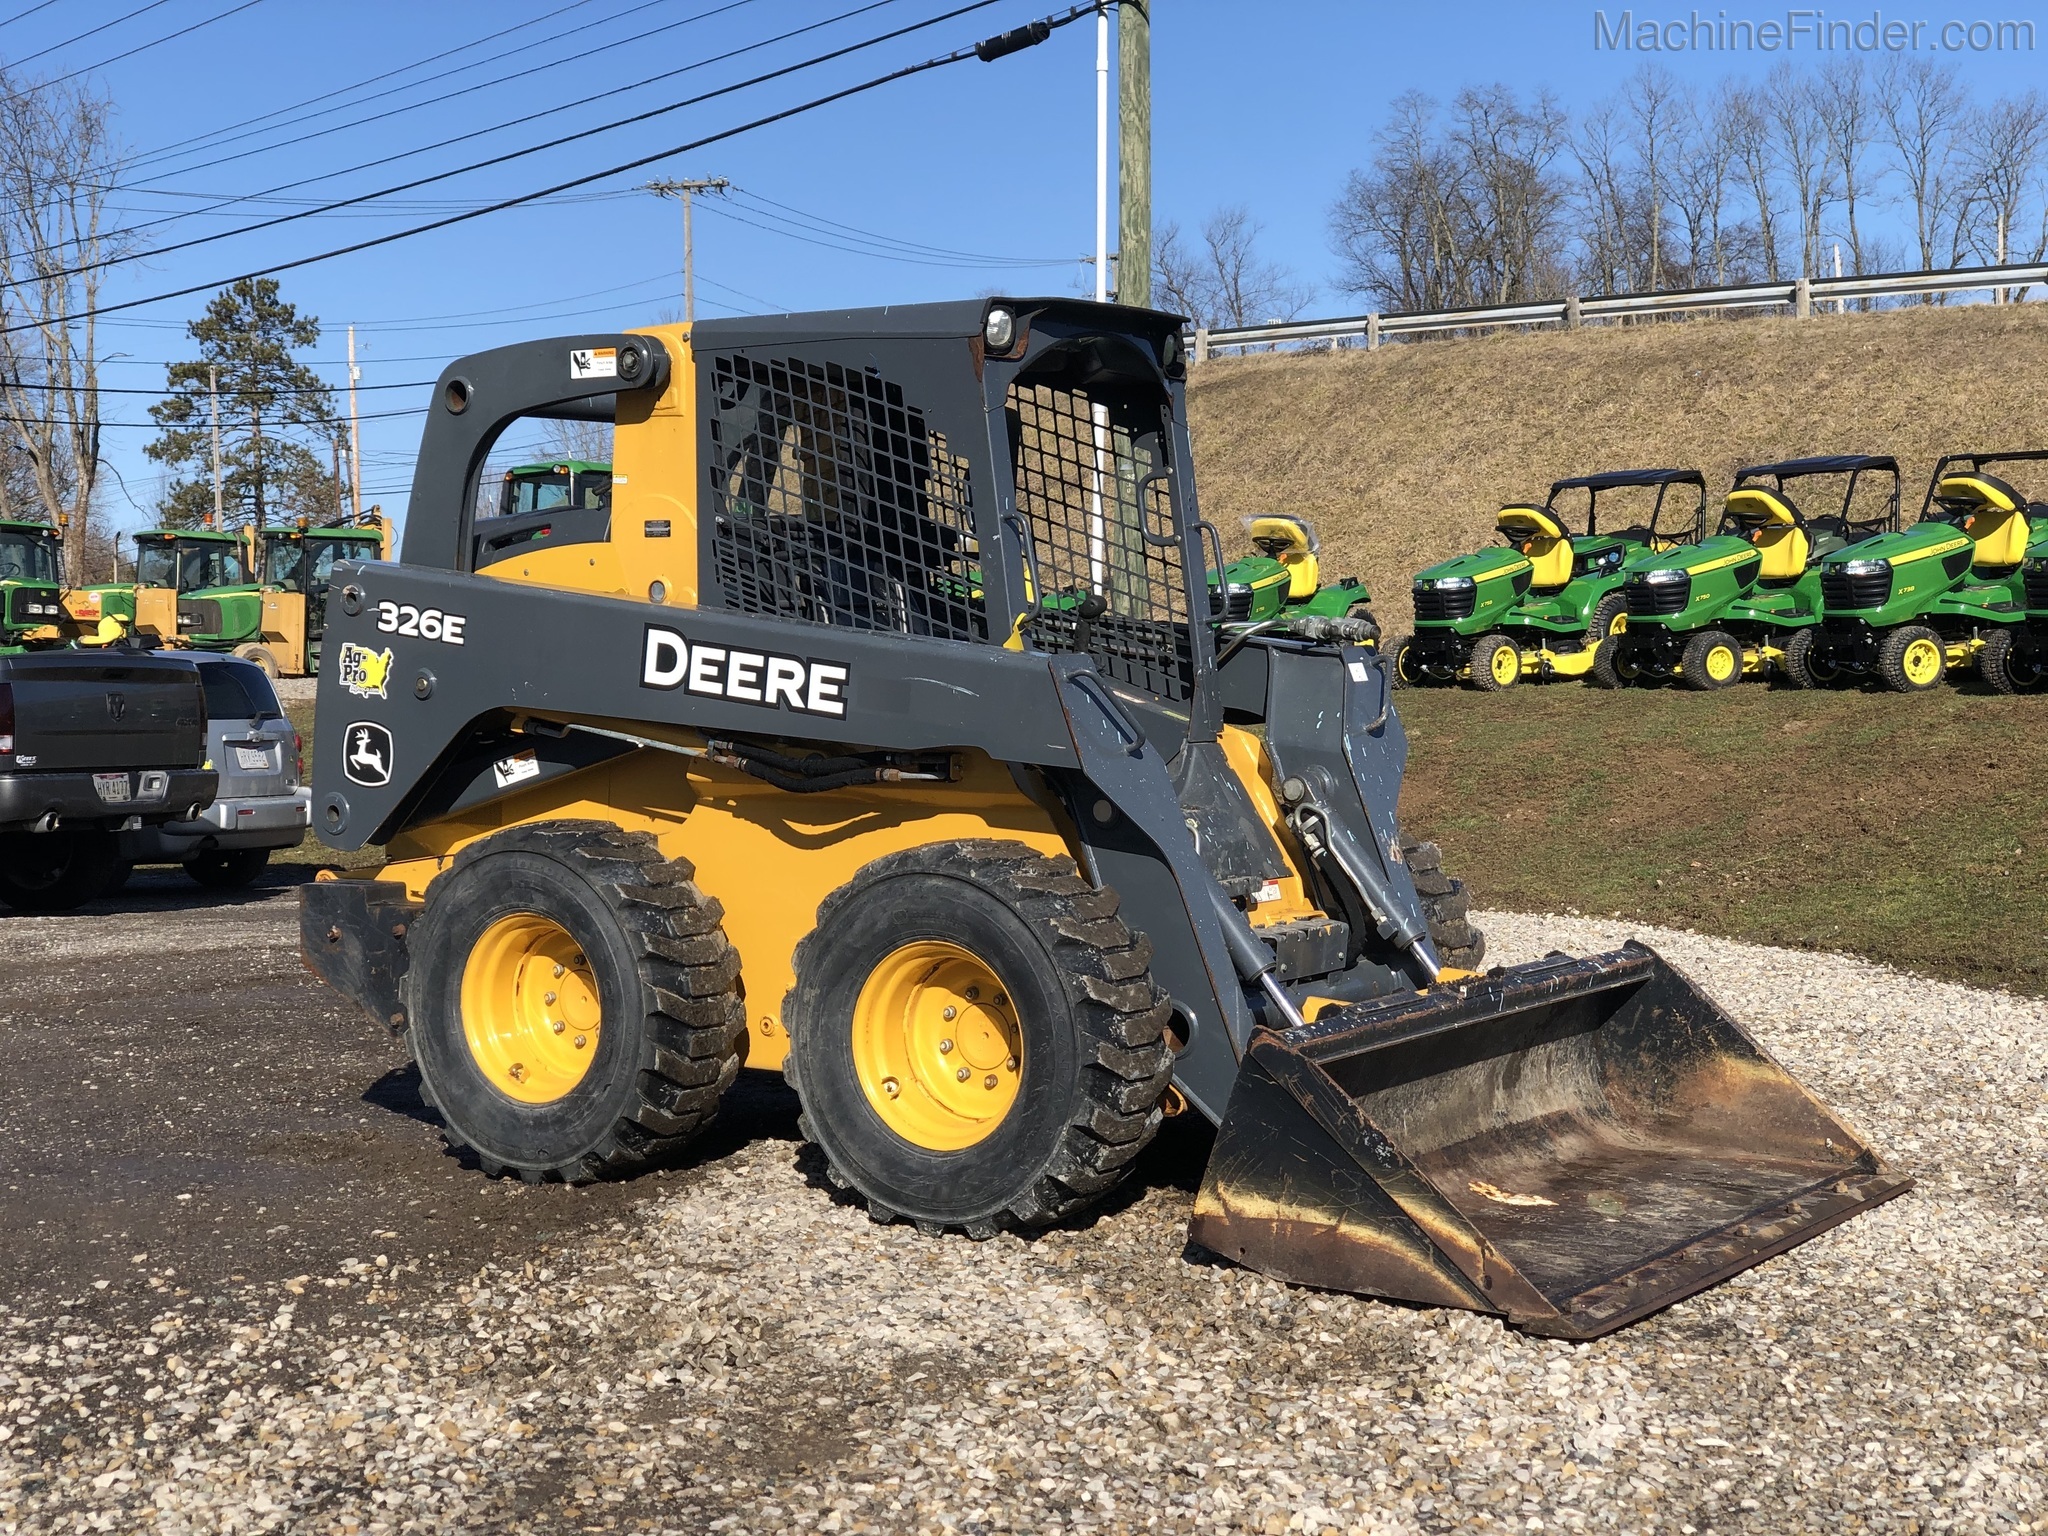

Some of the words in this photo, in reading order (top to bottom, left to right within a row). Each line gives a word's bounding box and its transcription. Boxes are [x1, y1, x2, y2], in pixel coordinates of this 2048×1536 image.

[1737, 551, 1752, 560] DEERE
[1930, 546, 1946, 555] JOHN
[1945, 539, 1964, 550] DEERE
[377, 601, 466, 645] 326E
[342, 664, 367, 682] Pro
[642, 627, 848, 715] DEERE
